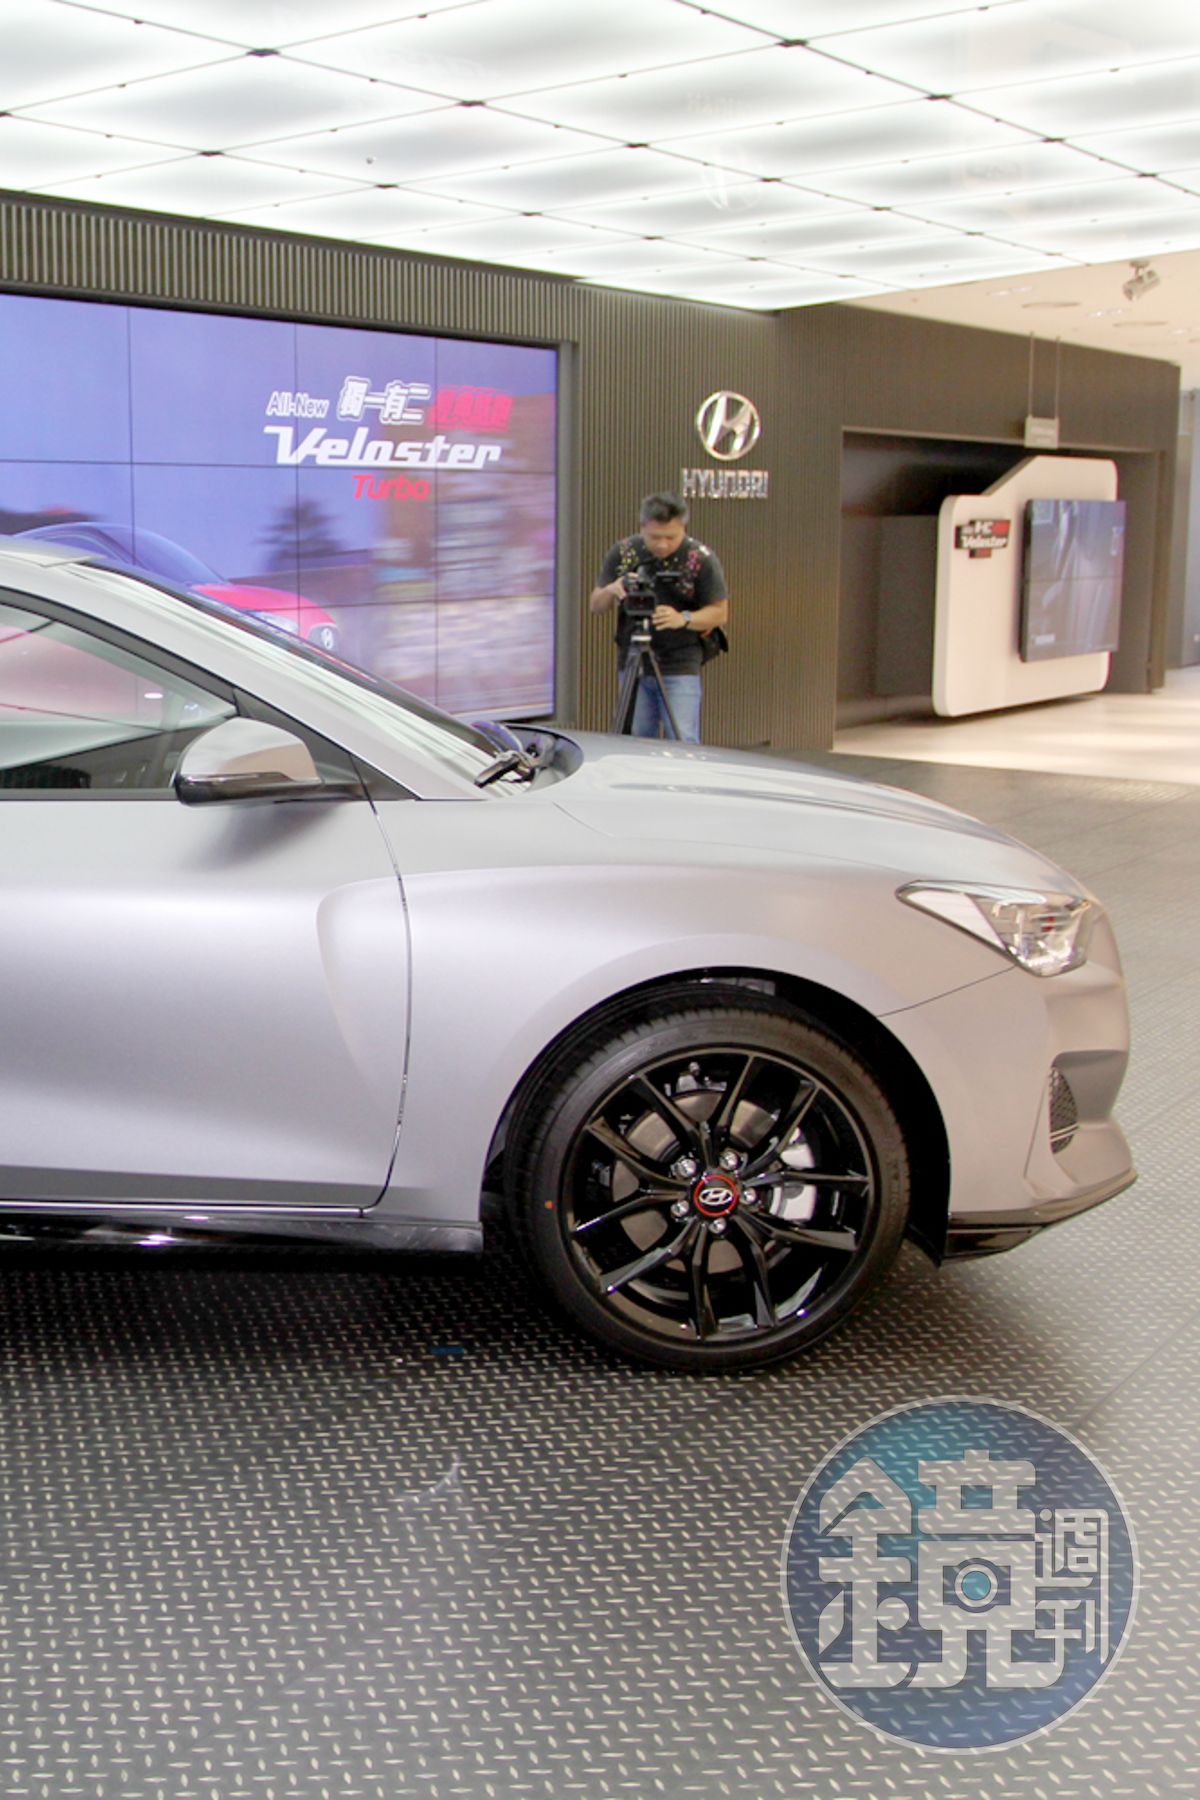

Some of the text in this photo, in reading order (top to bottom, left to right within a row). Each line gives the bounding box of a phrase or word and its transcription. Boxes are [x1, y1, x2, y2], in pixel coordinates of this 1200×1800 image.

[265, 391, 329, 418] All-New
[263, 426, 502, 470] Veloster
[352, 474, 430, 501] Turbo
[682, 467, 768, 499] HYUNDAI
